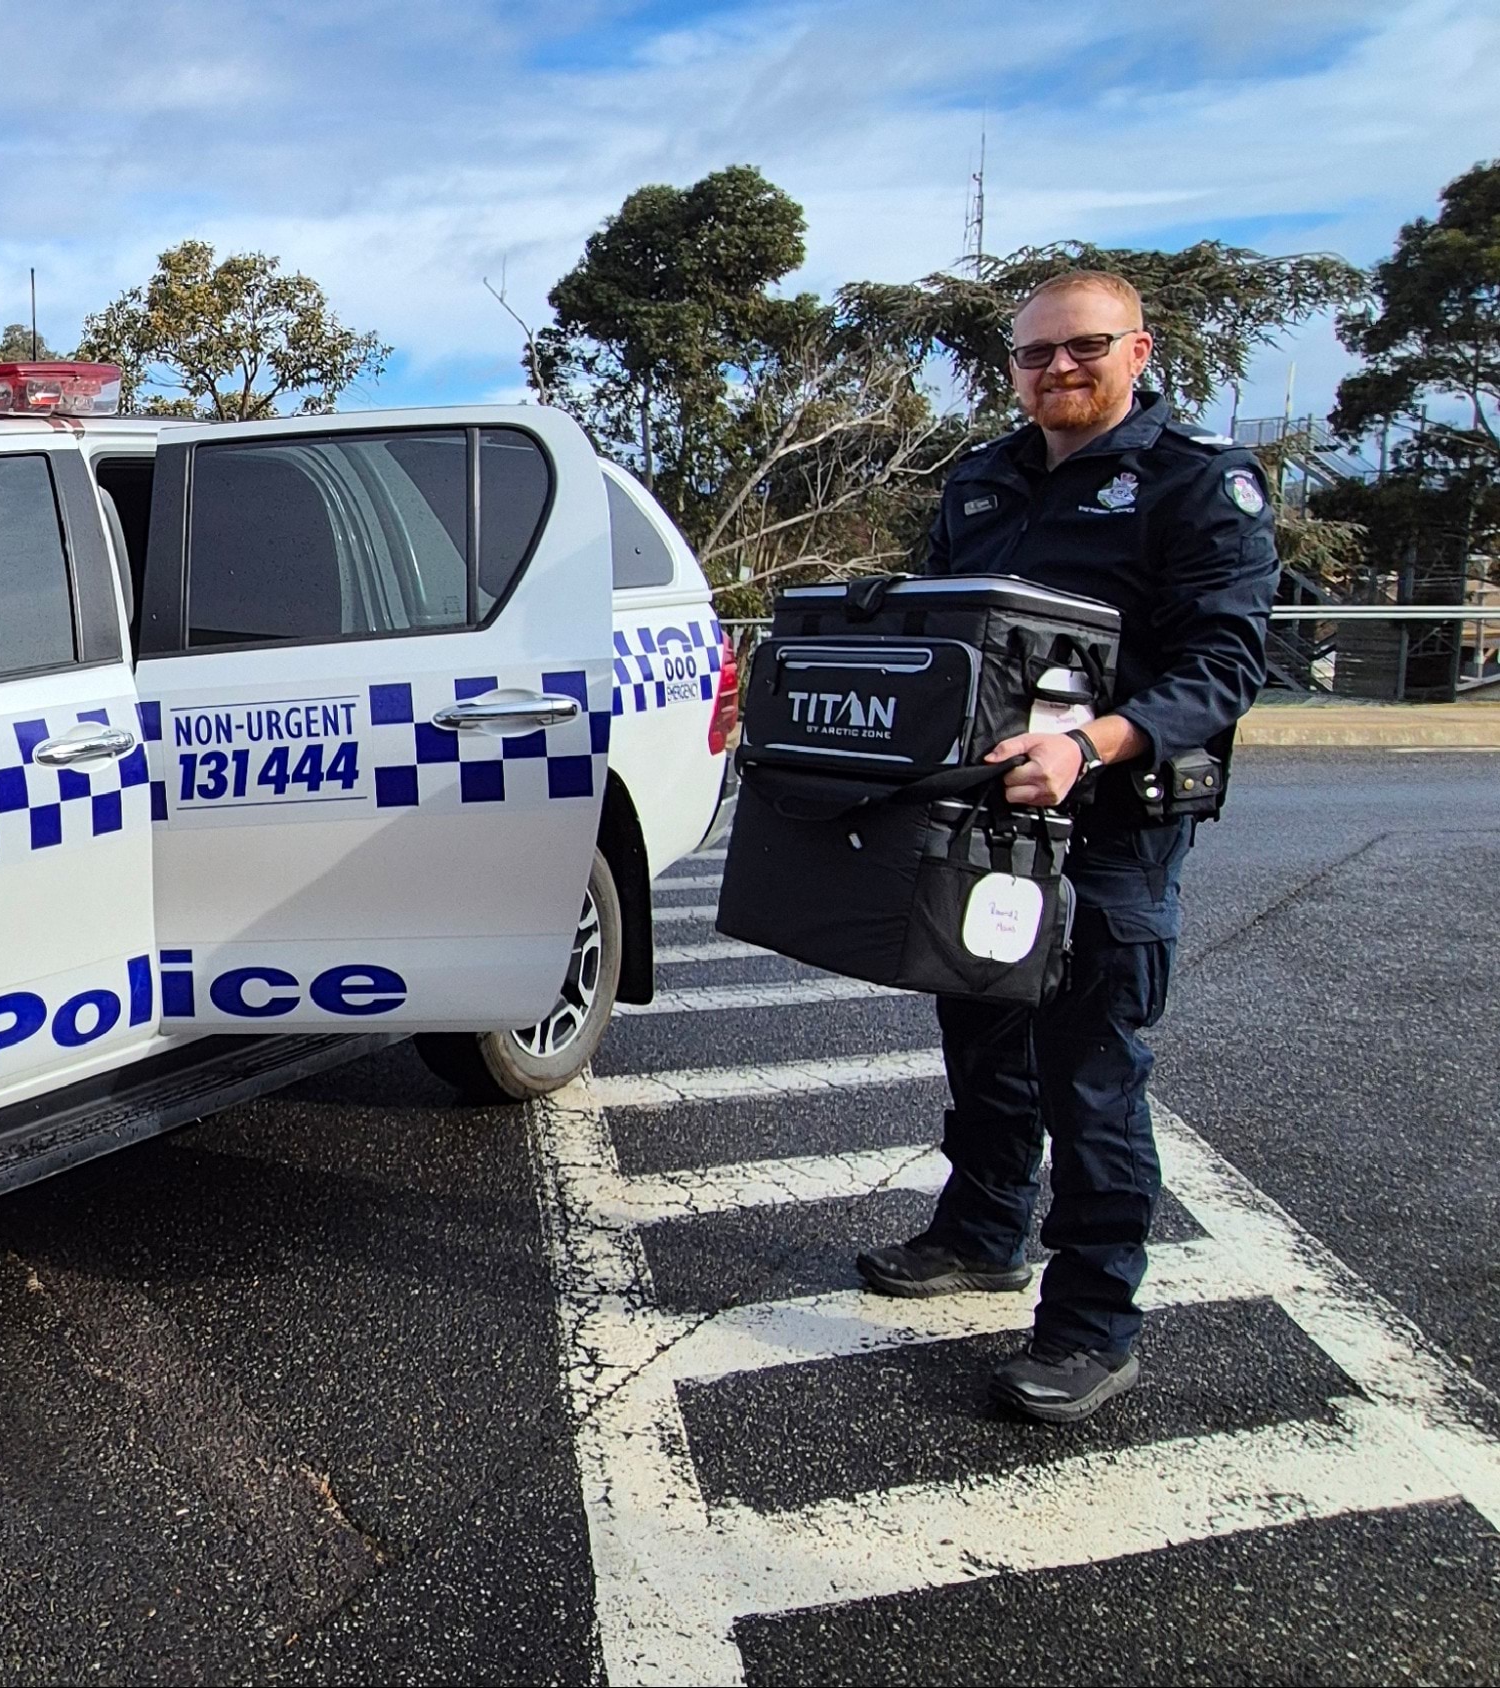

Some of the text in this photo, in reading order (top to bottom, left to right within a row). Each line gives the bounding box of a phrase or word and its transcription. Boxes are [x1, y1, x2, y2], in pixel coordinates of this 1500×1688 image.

[664, 655, 697, 681] 000
[174, 703, 356, 747] NON-URGENT
[788, 690, 897, 728] TITAN
[821, 726, 859, 737] ARCTIC
[861, 730, 891, 739] ZONE
[179, 741, 360, 801] 131 444
